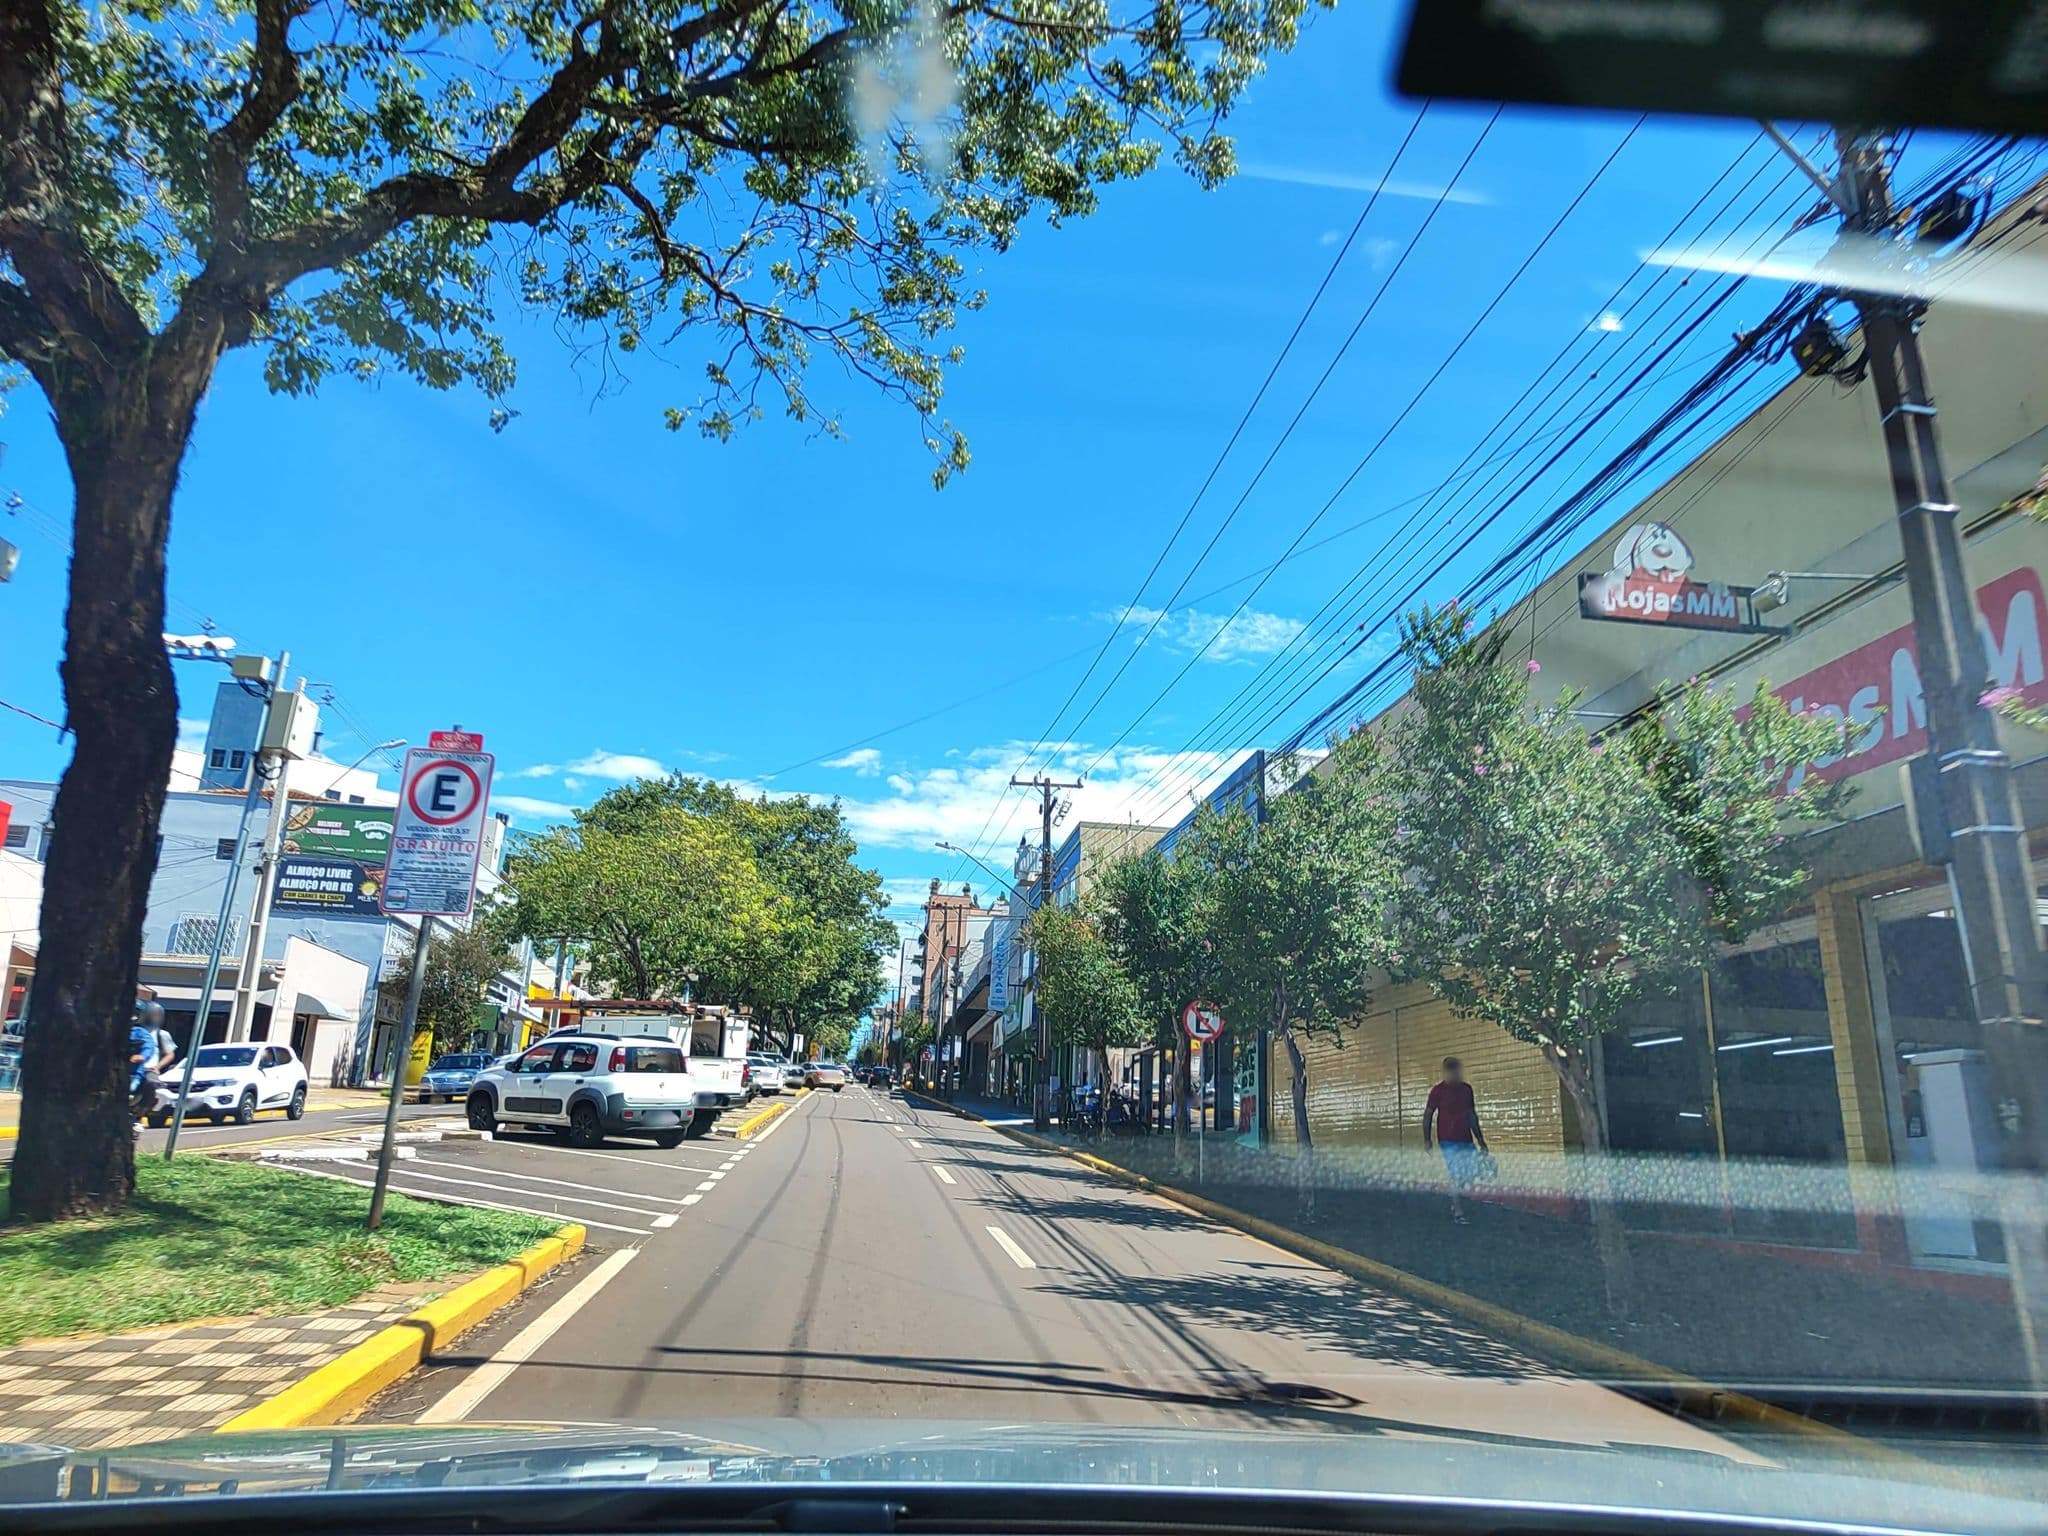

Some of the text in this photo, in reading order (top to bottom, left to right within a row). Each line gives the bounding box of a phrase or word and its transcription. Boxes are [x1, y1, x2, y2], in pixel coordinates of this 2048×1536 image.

[430, 773, 461, 812] E
[395, 838, 475, 853] GRATUITO
[286, 865, 353, 879] ALMOÇO LIVRE
[279, 878, 354, 893] ALMOÇO POR KG
